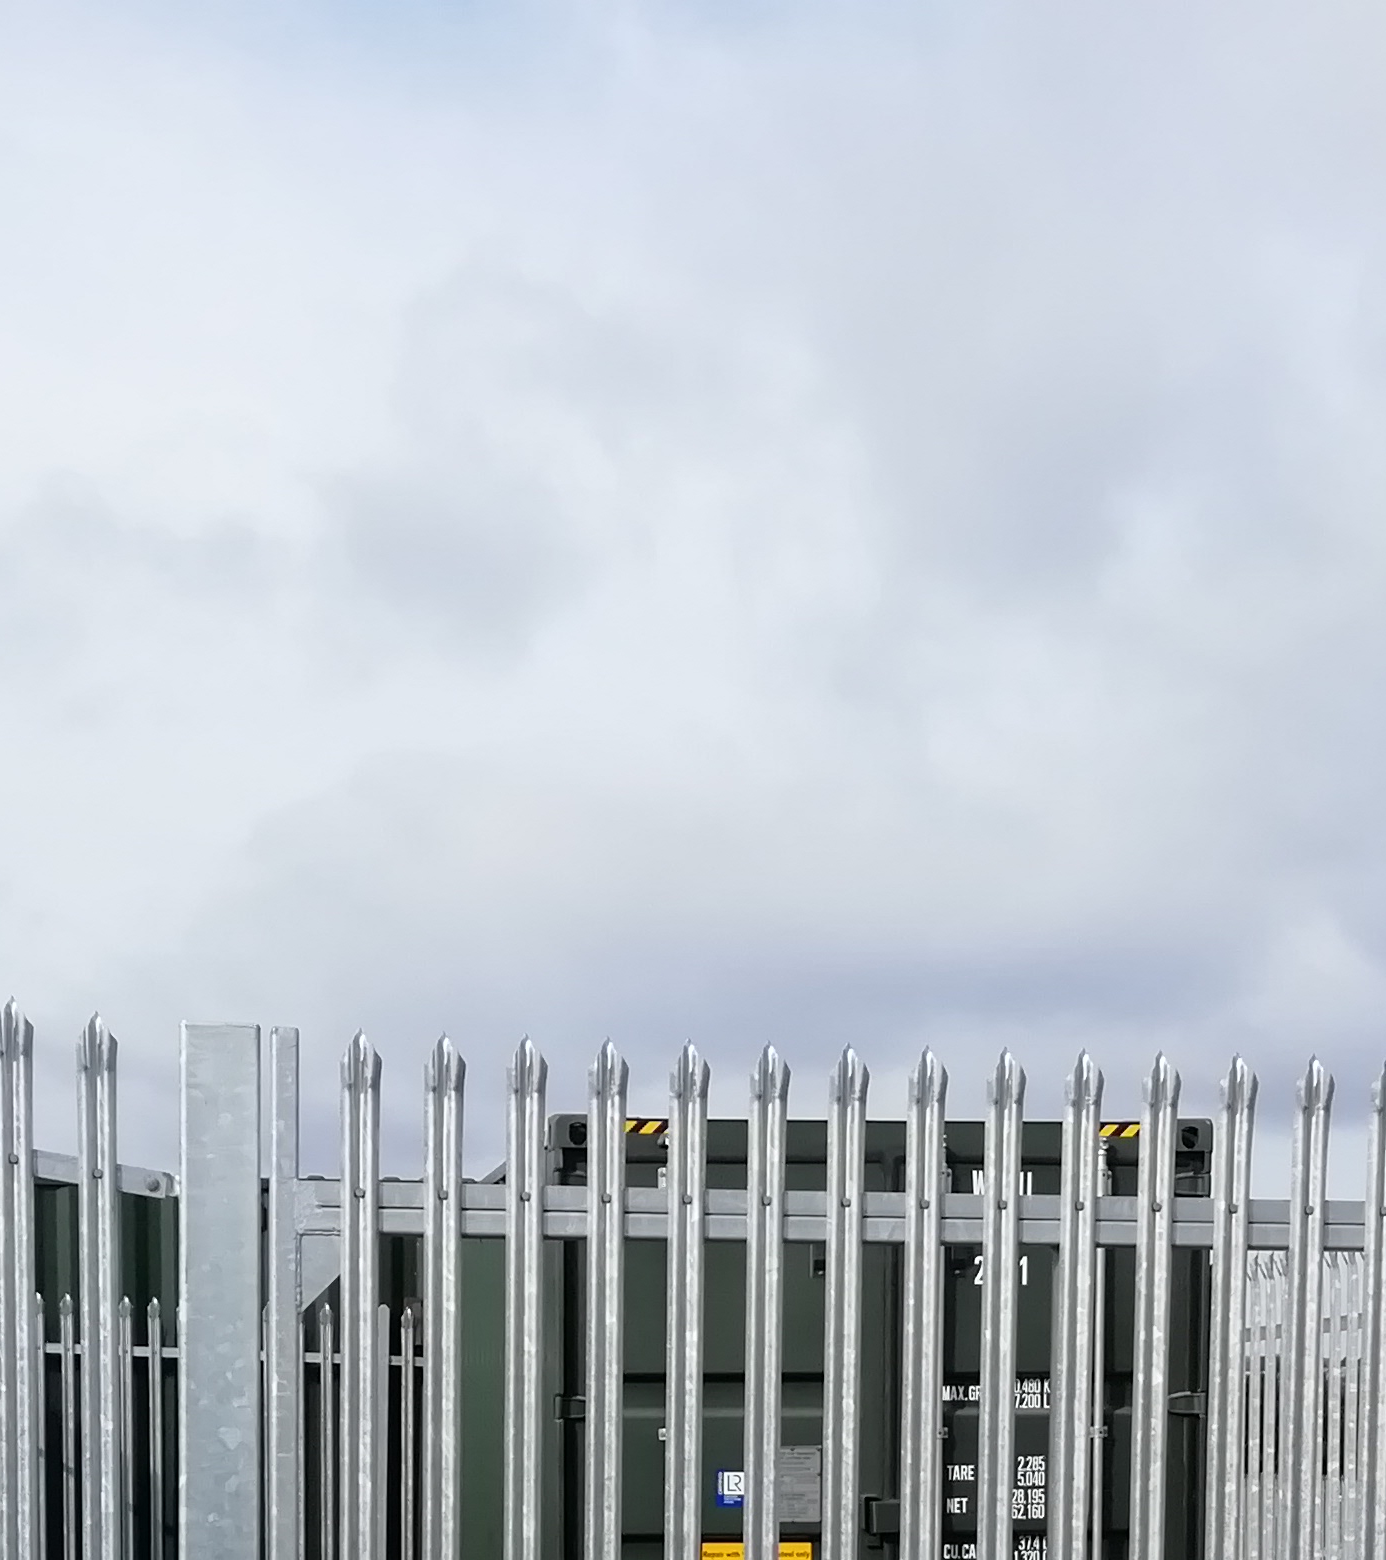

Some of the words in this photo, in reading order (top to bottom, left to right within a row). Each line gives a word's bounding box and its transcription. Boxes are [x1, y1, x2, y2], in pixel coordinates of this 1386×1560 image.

[1014, 1379, 1042, 1393] 0.480
[1014, 1393, 1041, 1408] 7.200
[947, 1465, 975, 1481] TARE
[946, 1498, 968, 1514] NET
